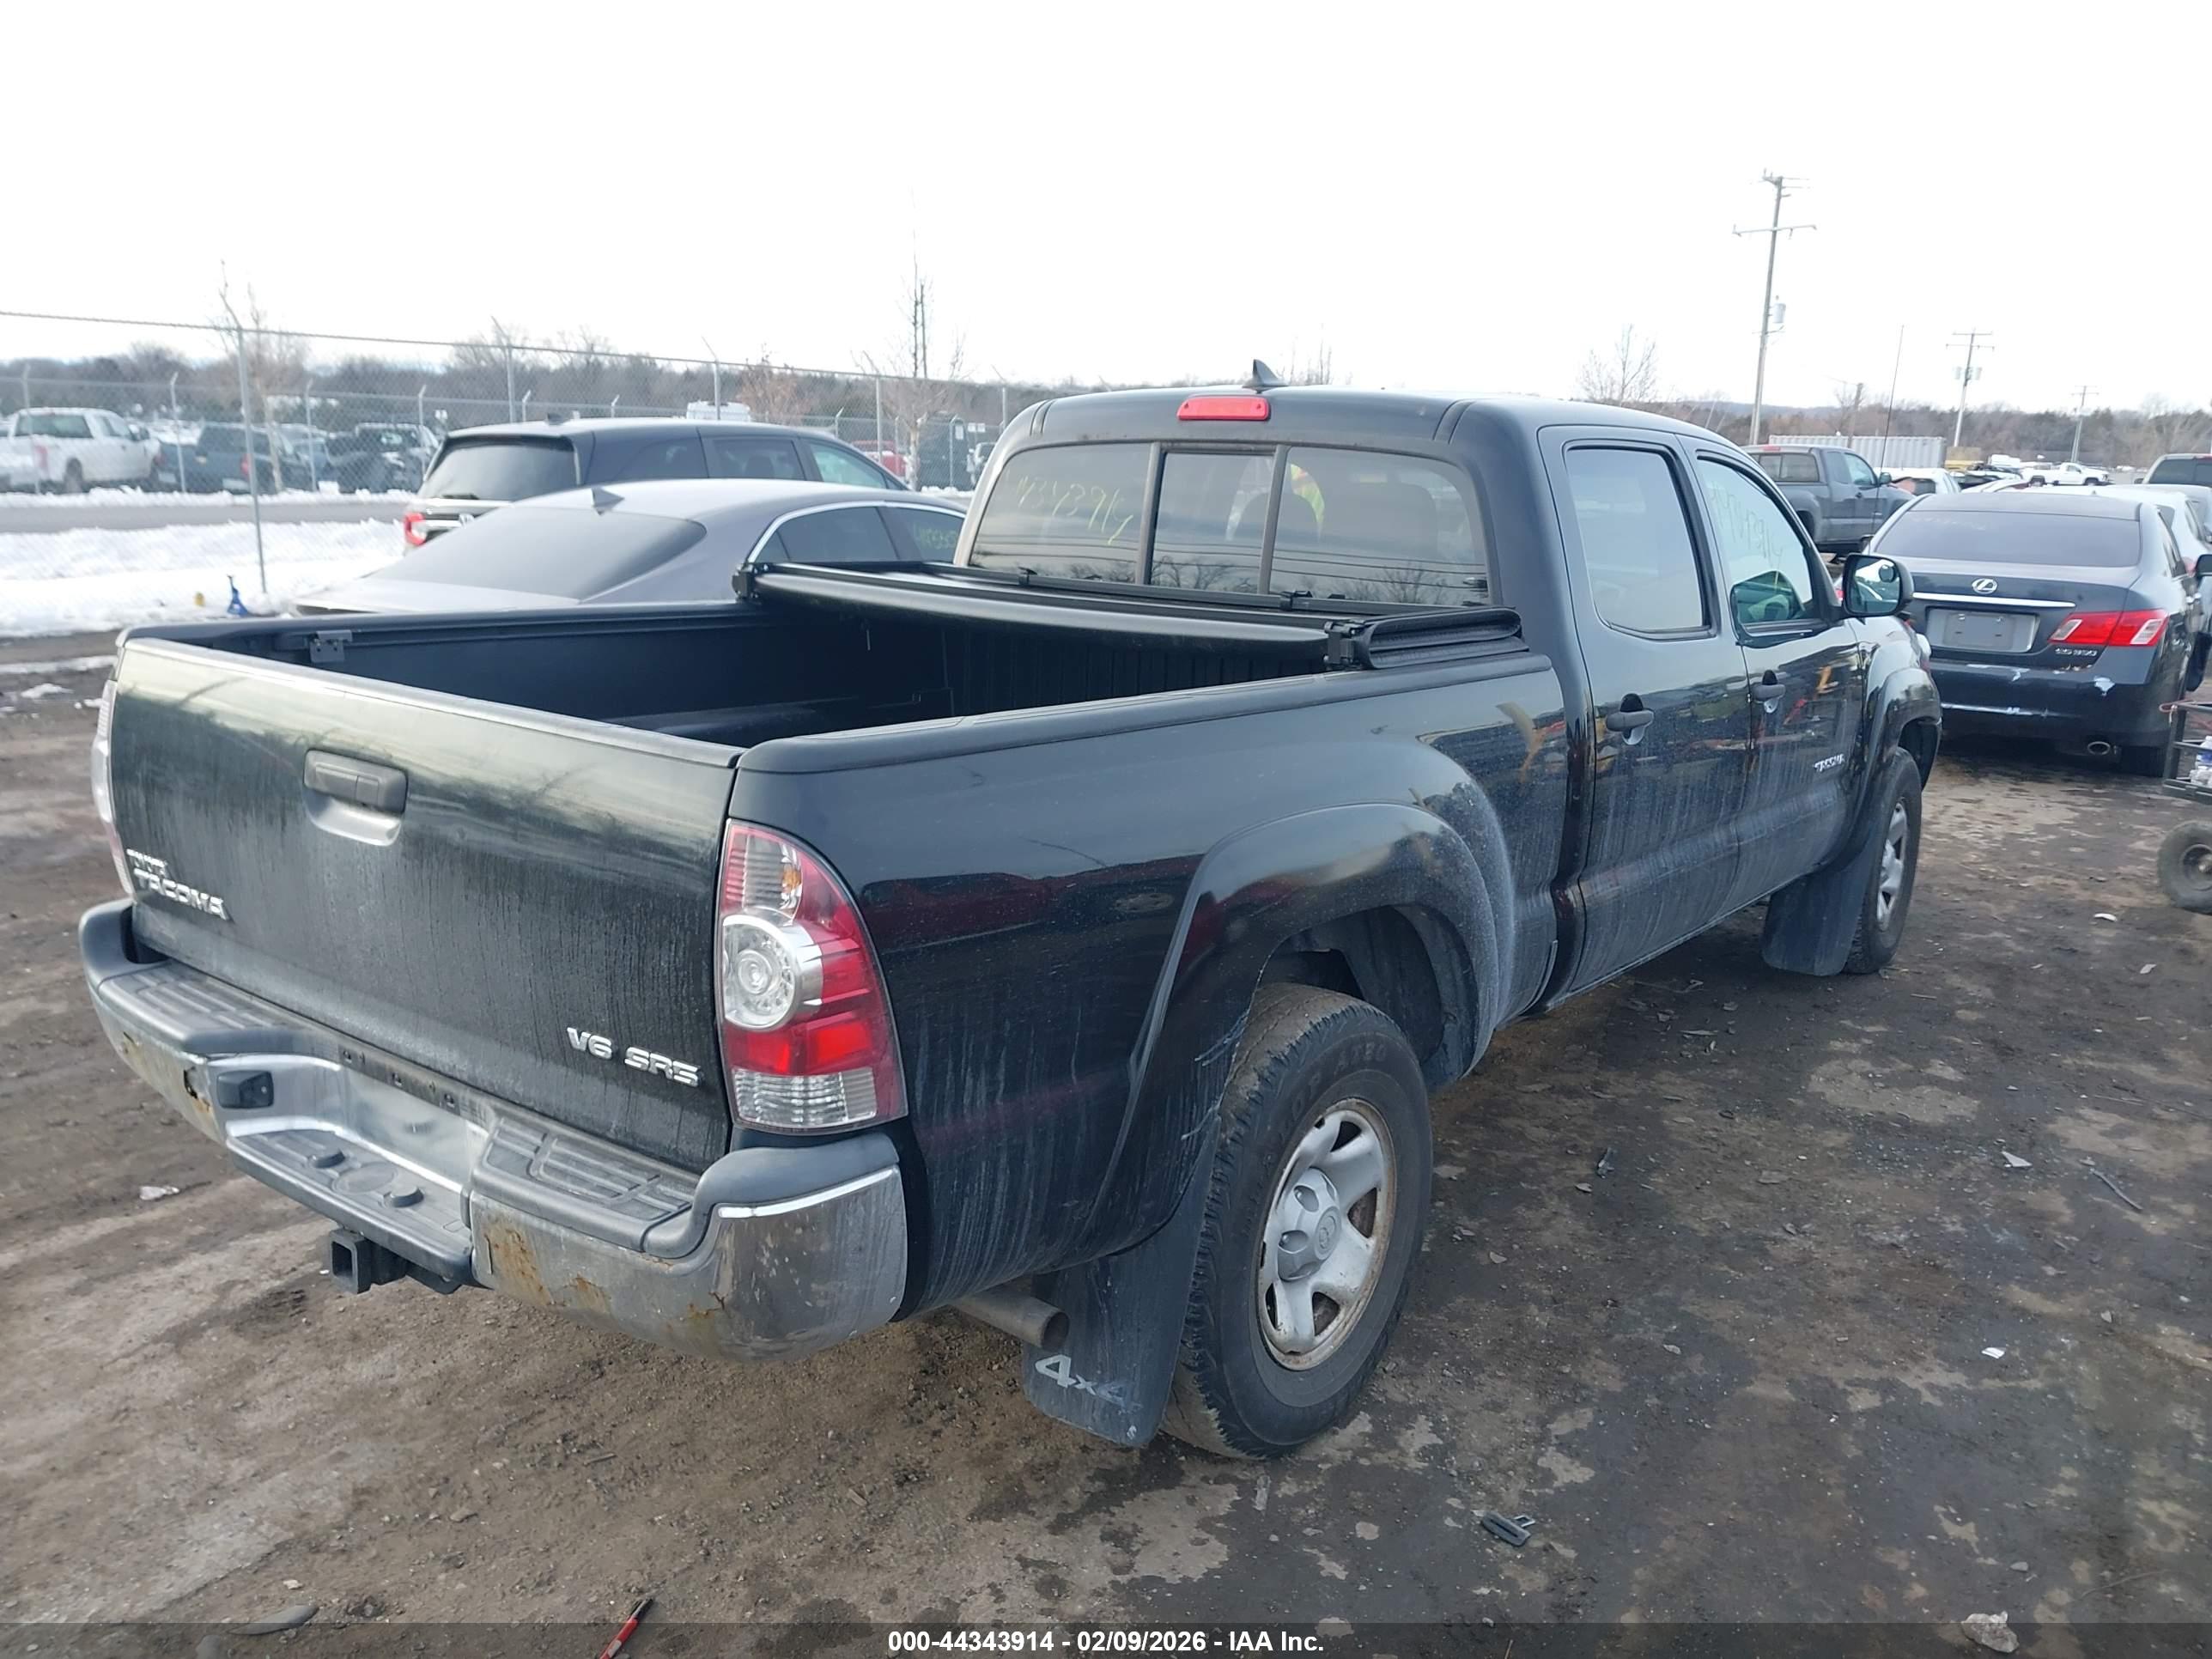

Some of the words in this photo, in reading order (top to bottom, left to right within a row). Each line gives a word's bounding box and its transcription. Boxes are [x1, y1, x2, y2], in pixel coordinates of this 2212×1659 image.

[133, 867, 228, 921] TACOMA
[567, 1027, 612, 1060] V6
[624, 1047, 700, 1088] SR5
